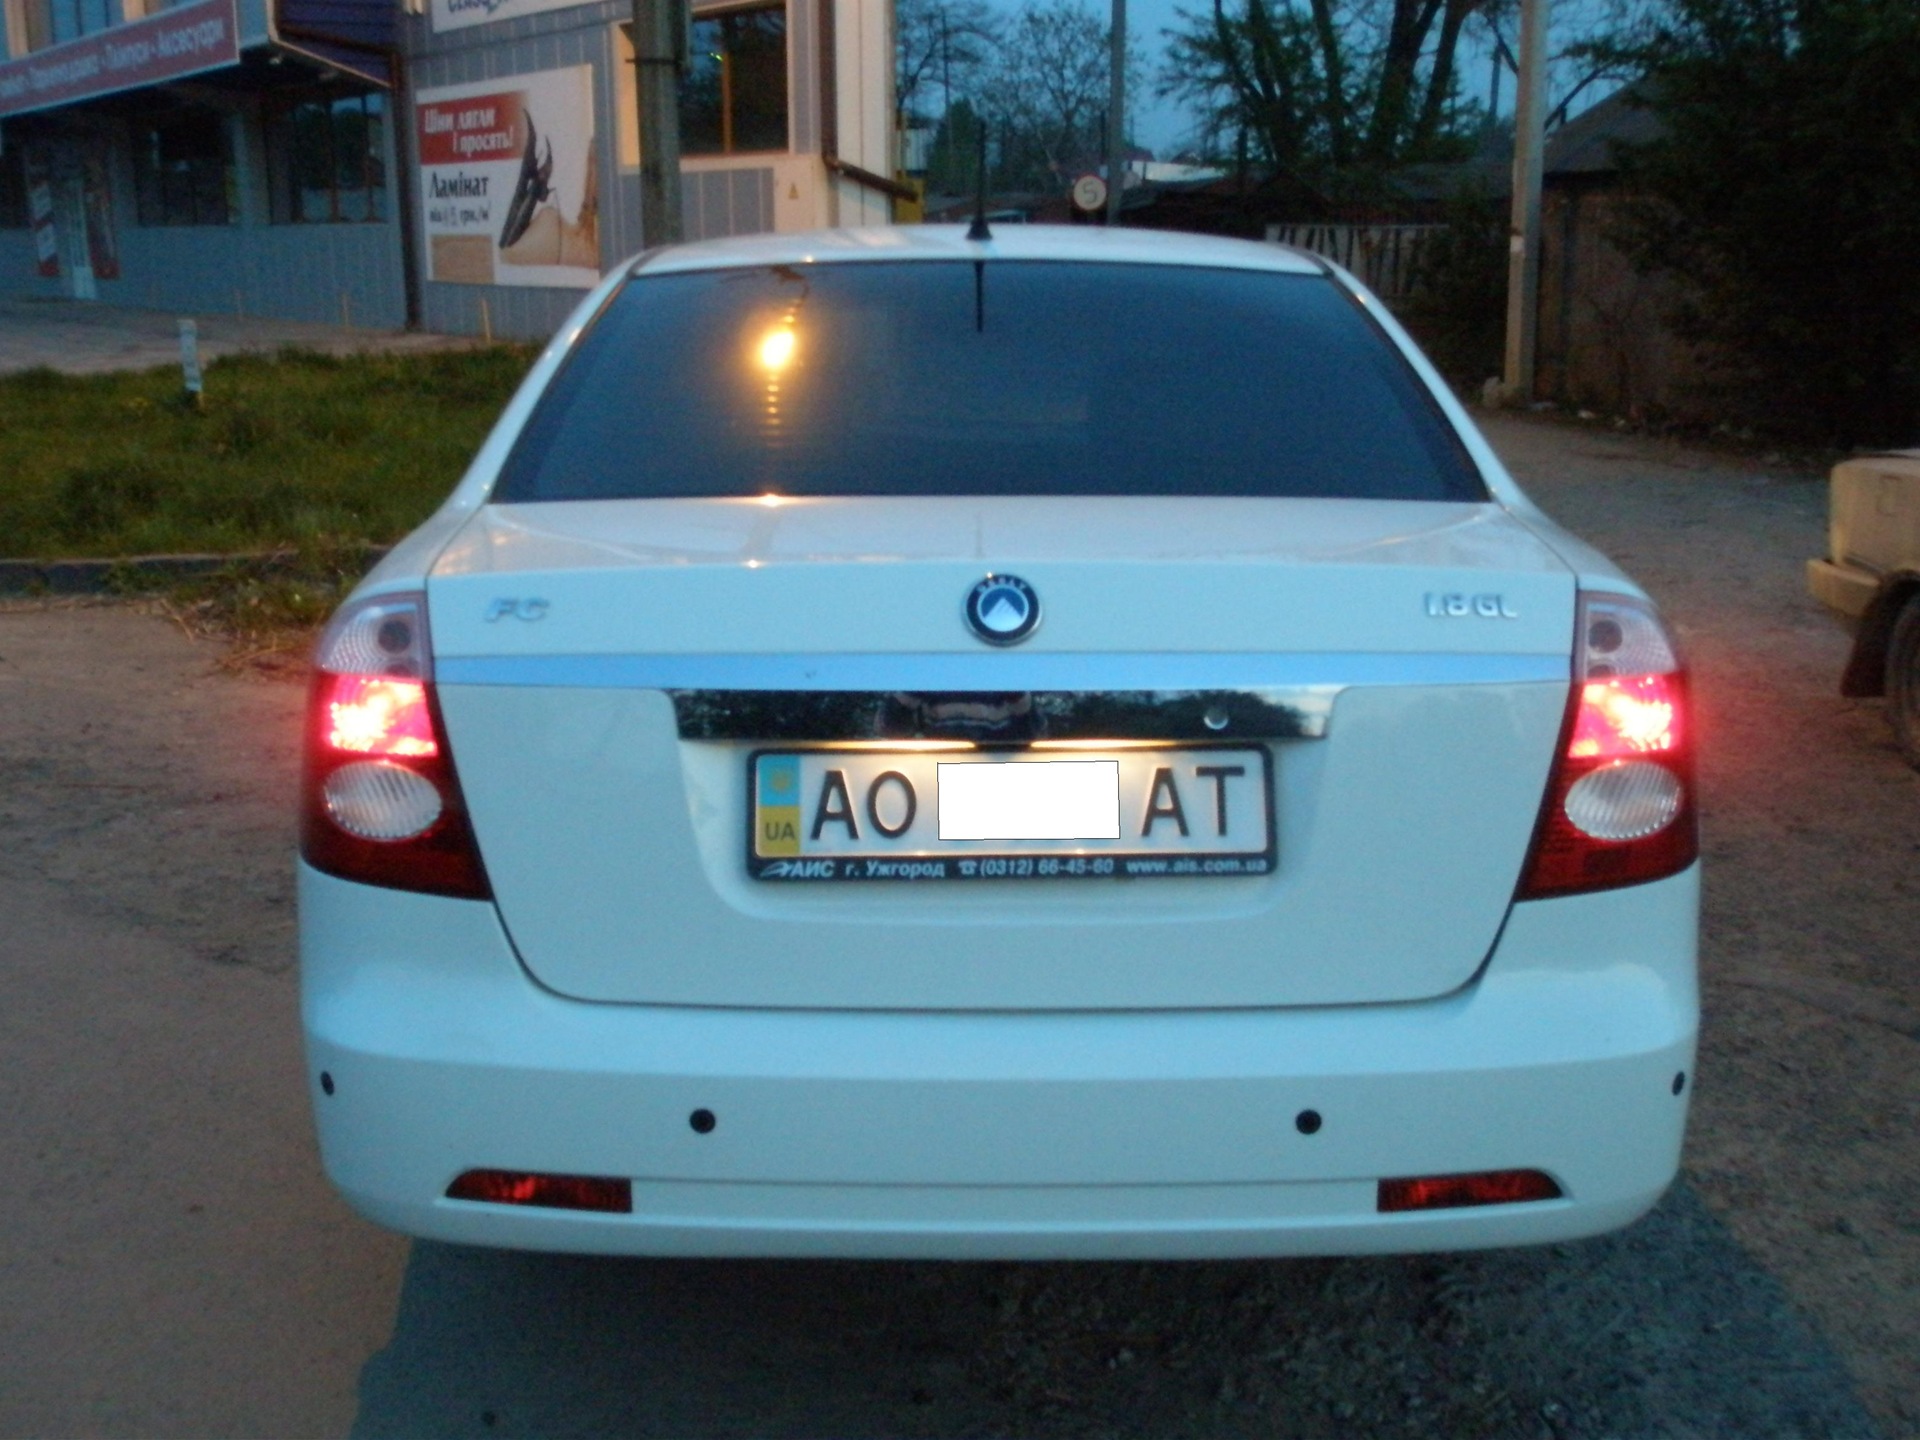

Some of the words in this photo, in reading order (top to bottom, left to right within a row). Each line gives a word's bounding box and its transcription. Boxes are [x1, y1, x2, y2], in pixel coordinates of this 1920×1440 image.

[429, 171, 489, 198] Ламінат
[484, 597, 550, 623] FC
[1471, 592, 1520, 618] GL
[1141, 767, 1246, 837] AT
[765, 822, 796, 842] UA
[866, 860, 945, 880] Ужгород
[980, 860, 1033, 876] (0312)
[1126, 859, 1267, 874] www.ais.com.ua
